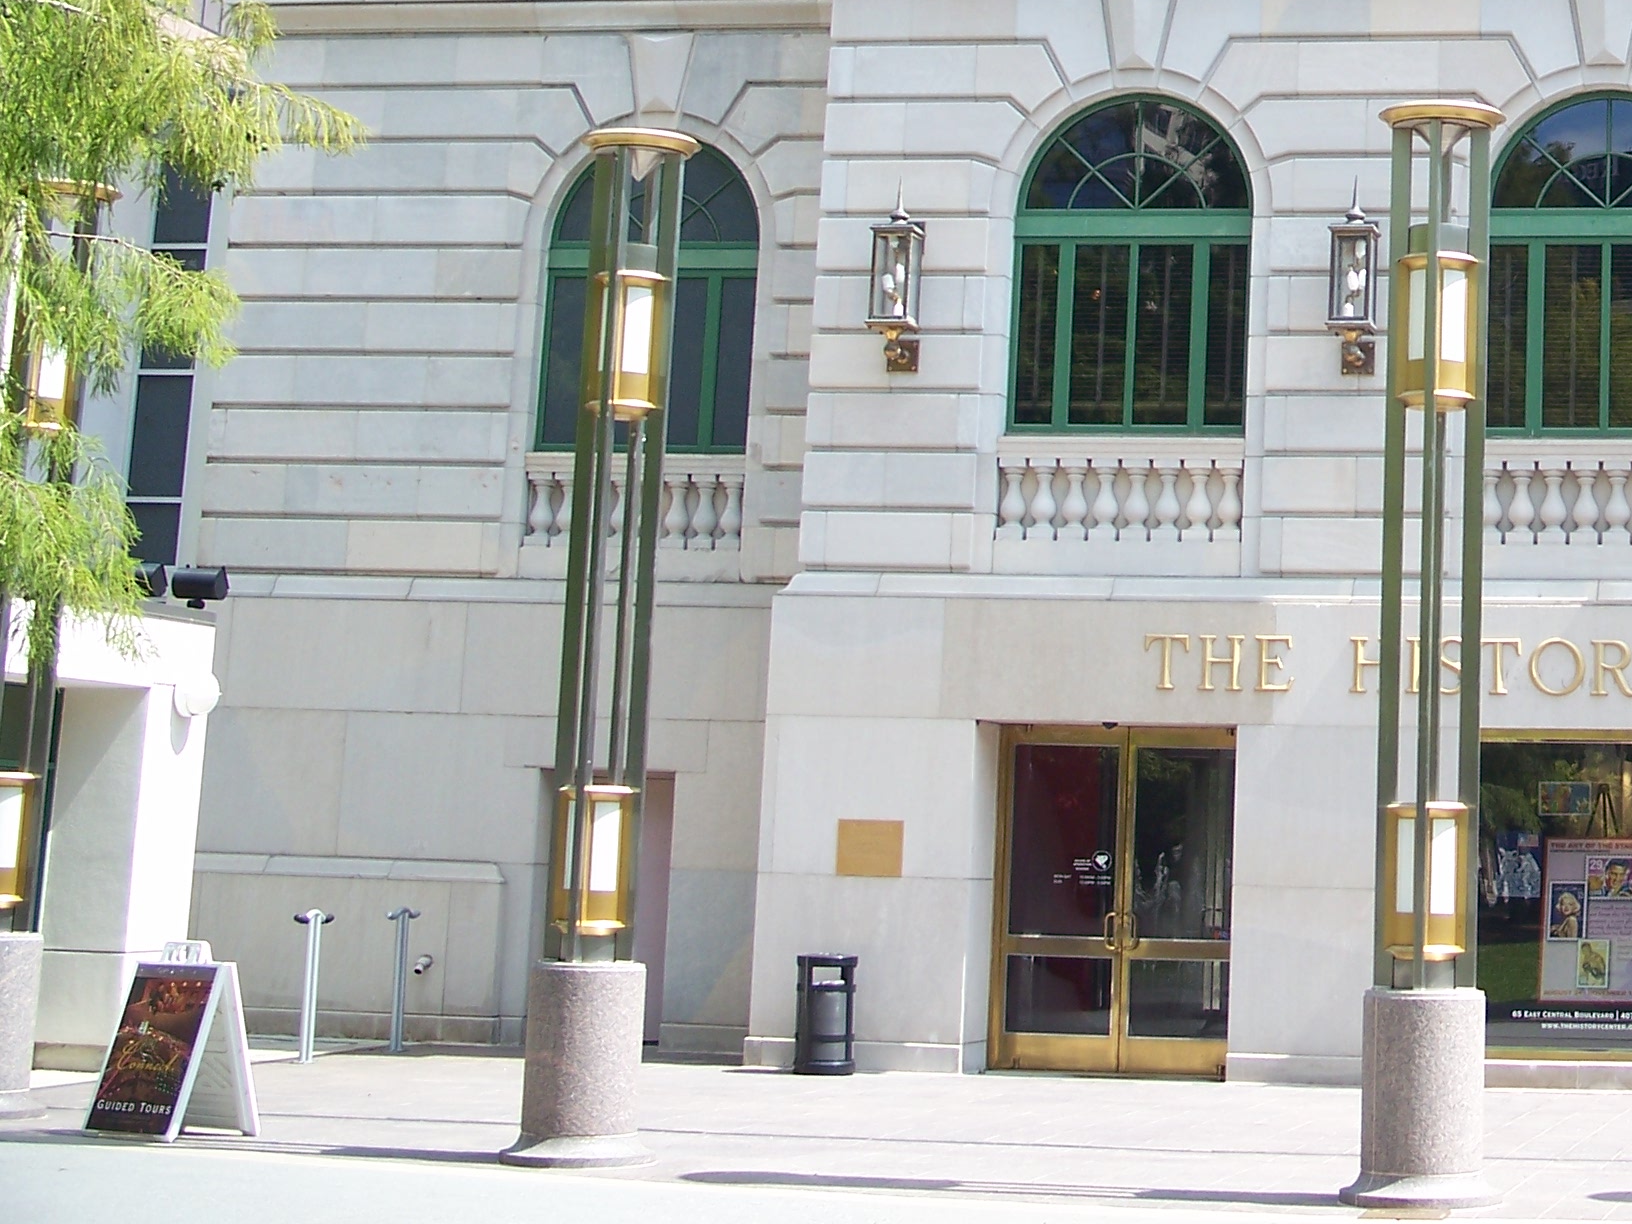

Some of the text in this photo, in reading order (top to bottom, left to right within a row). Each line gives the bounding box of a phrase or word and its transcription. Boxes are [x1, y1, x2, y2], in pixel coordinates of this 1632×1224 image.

[1143, 633, 1295, 694] THE
[1542, 1010, 1573, 1019] CENTRAL
[96, 1099, 172, 1115] GUIDED TOURS
